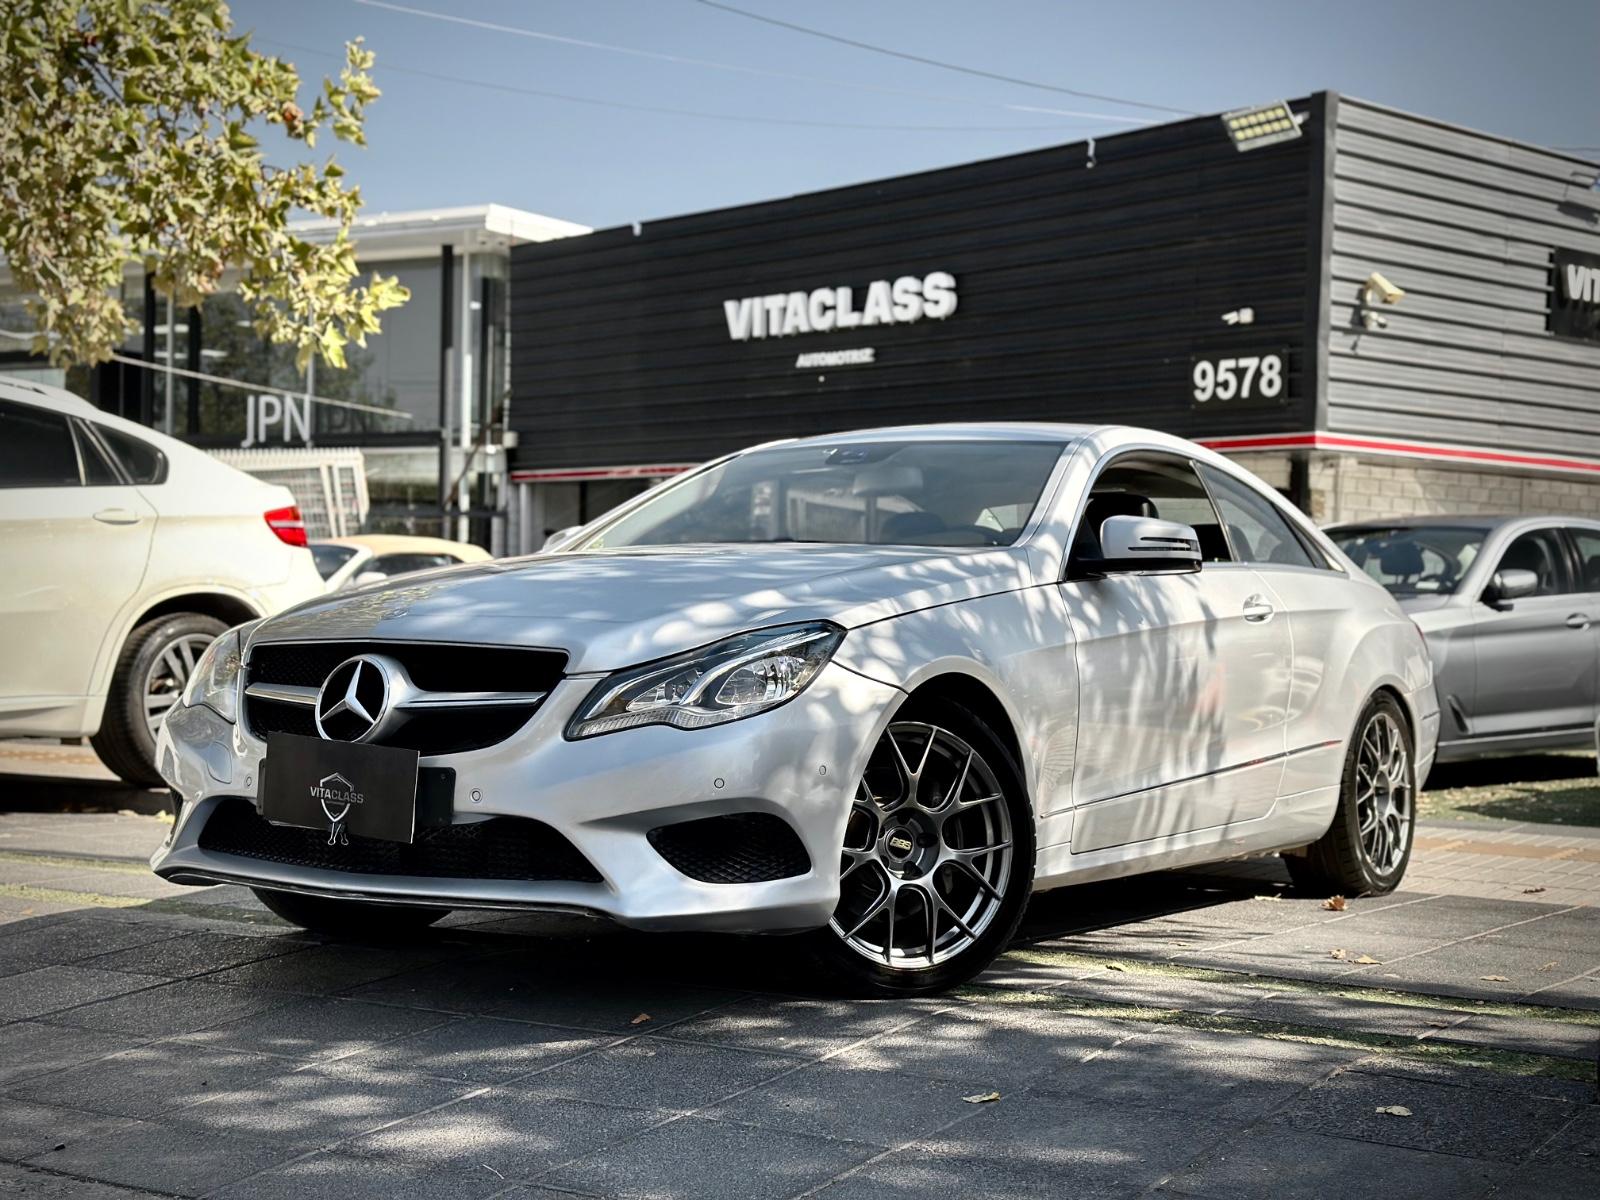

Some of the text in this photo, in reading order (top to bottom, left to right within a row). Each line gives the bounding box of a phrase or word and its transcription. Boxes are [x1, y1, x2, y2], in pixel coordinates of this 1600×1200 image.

[723, 271, 958, 341] VITACLASS
[1192, 354, 1282, 402] 9578
[240, 394, 310, 447] JPN
[310, 786, 364, 804] VITACLASS
